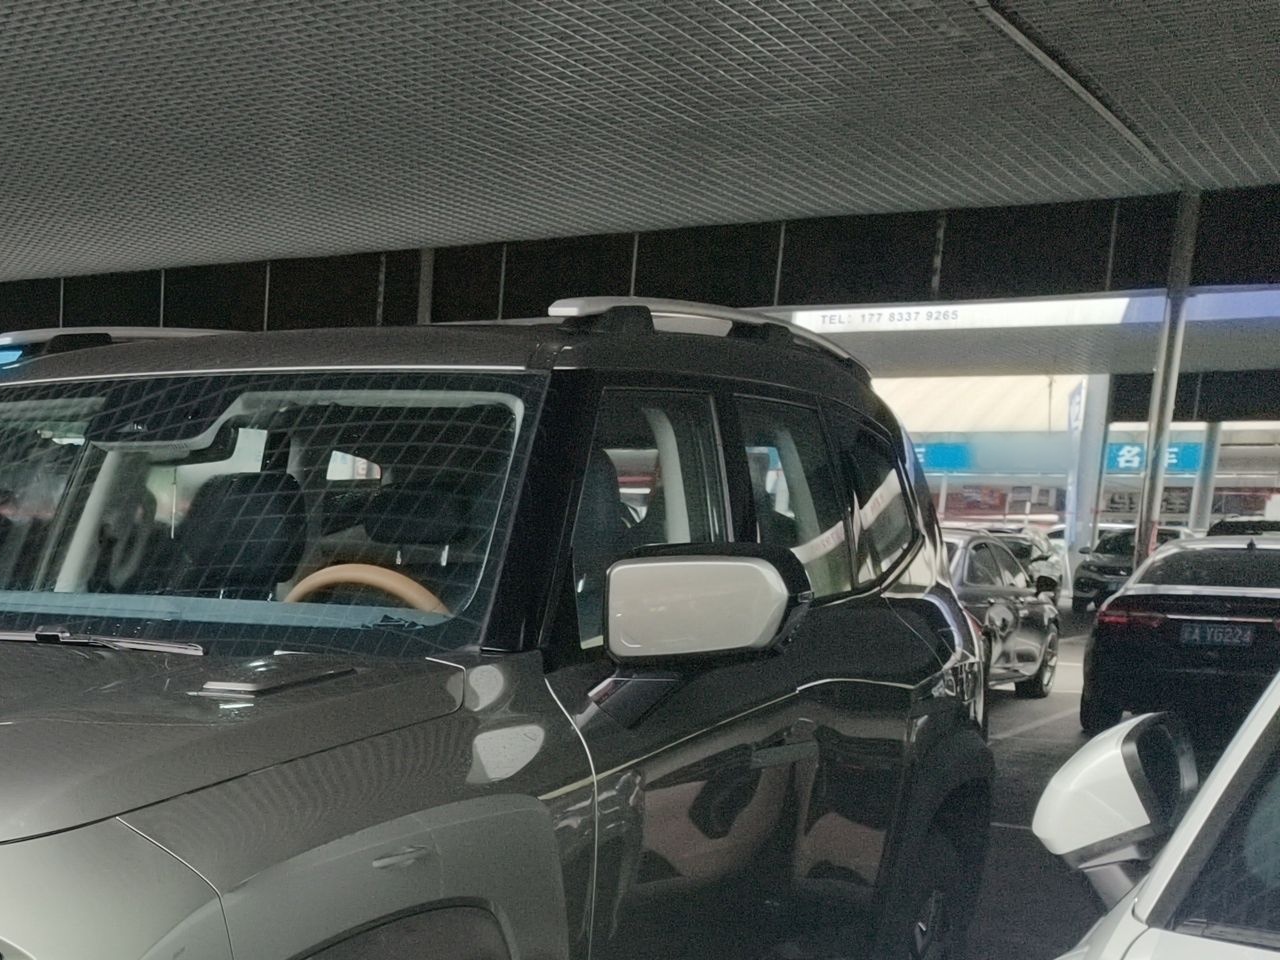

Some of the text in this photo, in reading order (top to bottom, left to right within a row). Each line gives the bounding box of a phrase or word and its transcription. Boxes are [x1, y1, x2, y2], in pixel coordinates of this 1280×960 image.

[861, 312, 882, 323] 177
[888, 311, 920, 322] 8337
[926, 310, 959, 321] 9265
